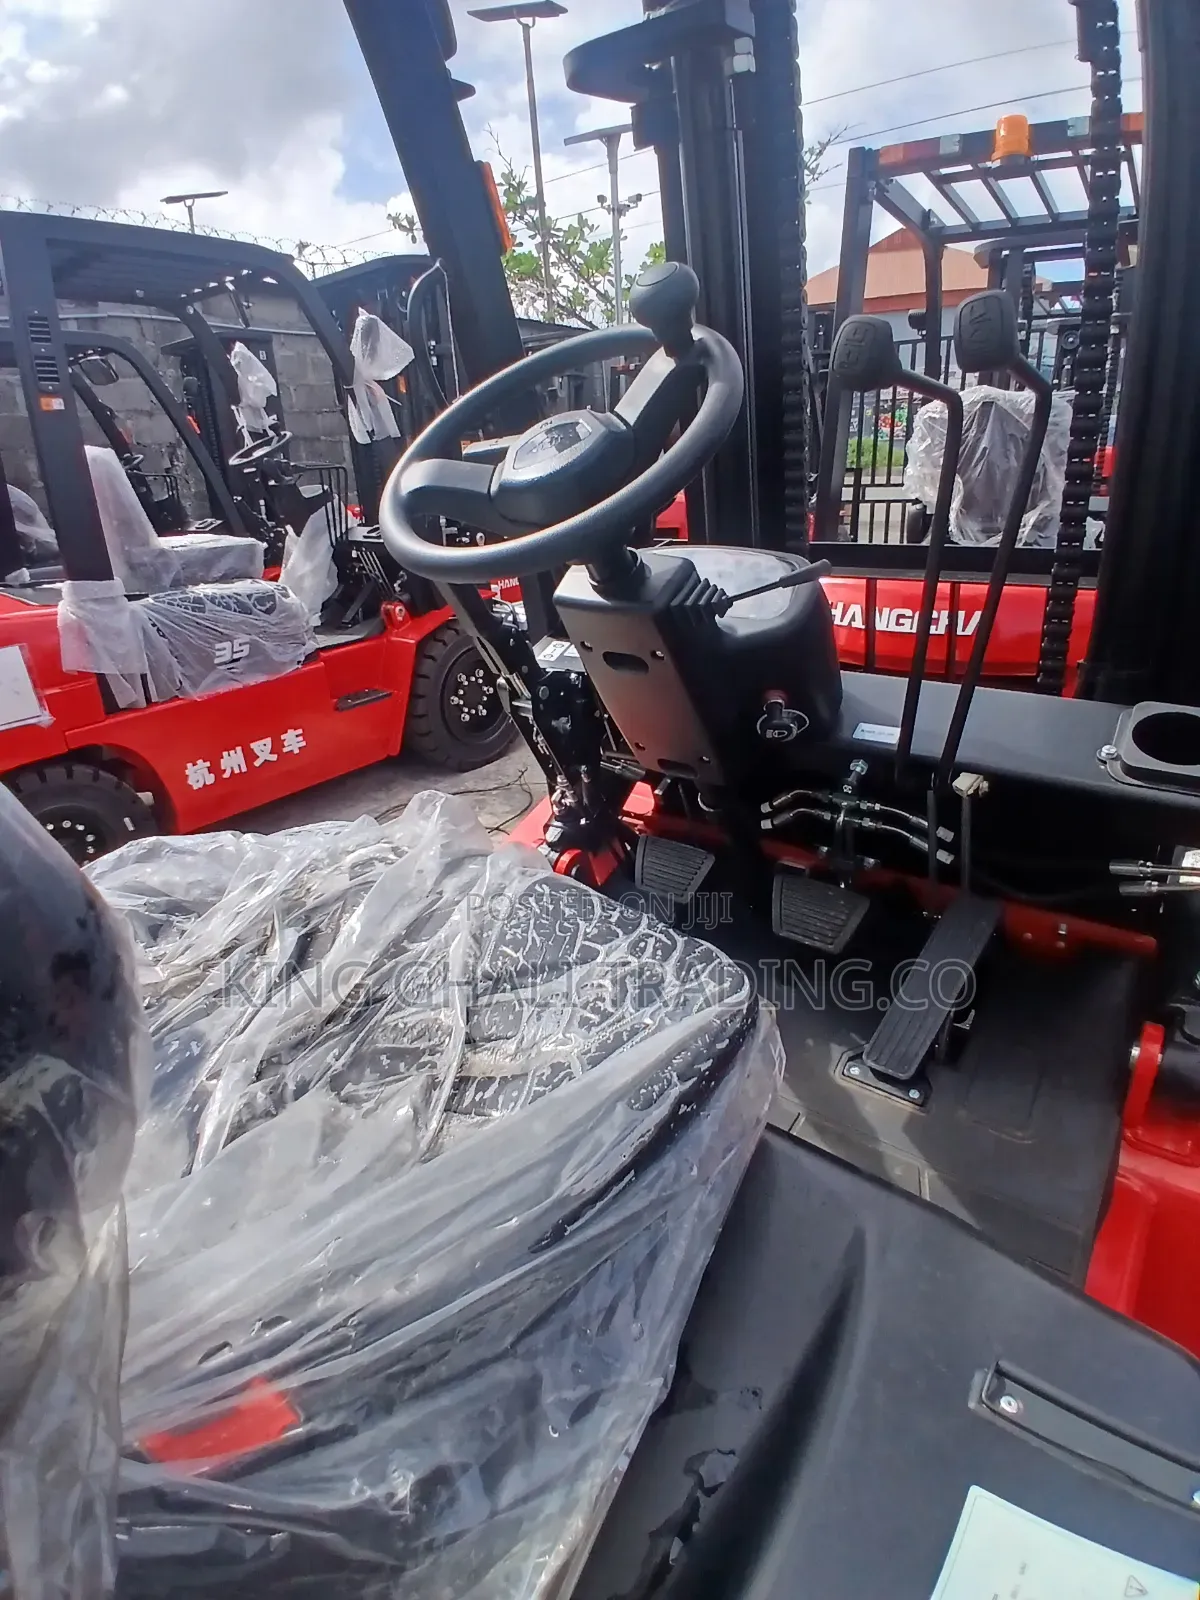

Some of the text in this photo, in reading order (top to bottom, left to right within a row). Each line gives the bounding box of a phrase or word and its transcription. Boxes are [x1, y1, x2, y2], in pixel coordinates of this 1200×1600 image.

[213, 638, 251, 665] 35
[184, 728, 307, 790] 杭州叉车
